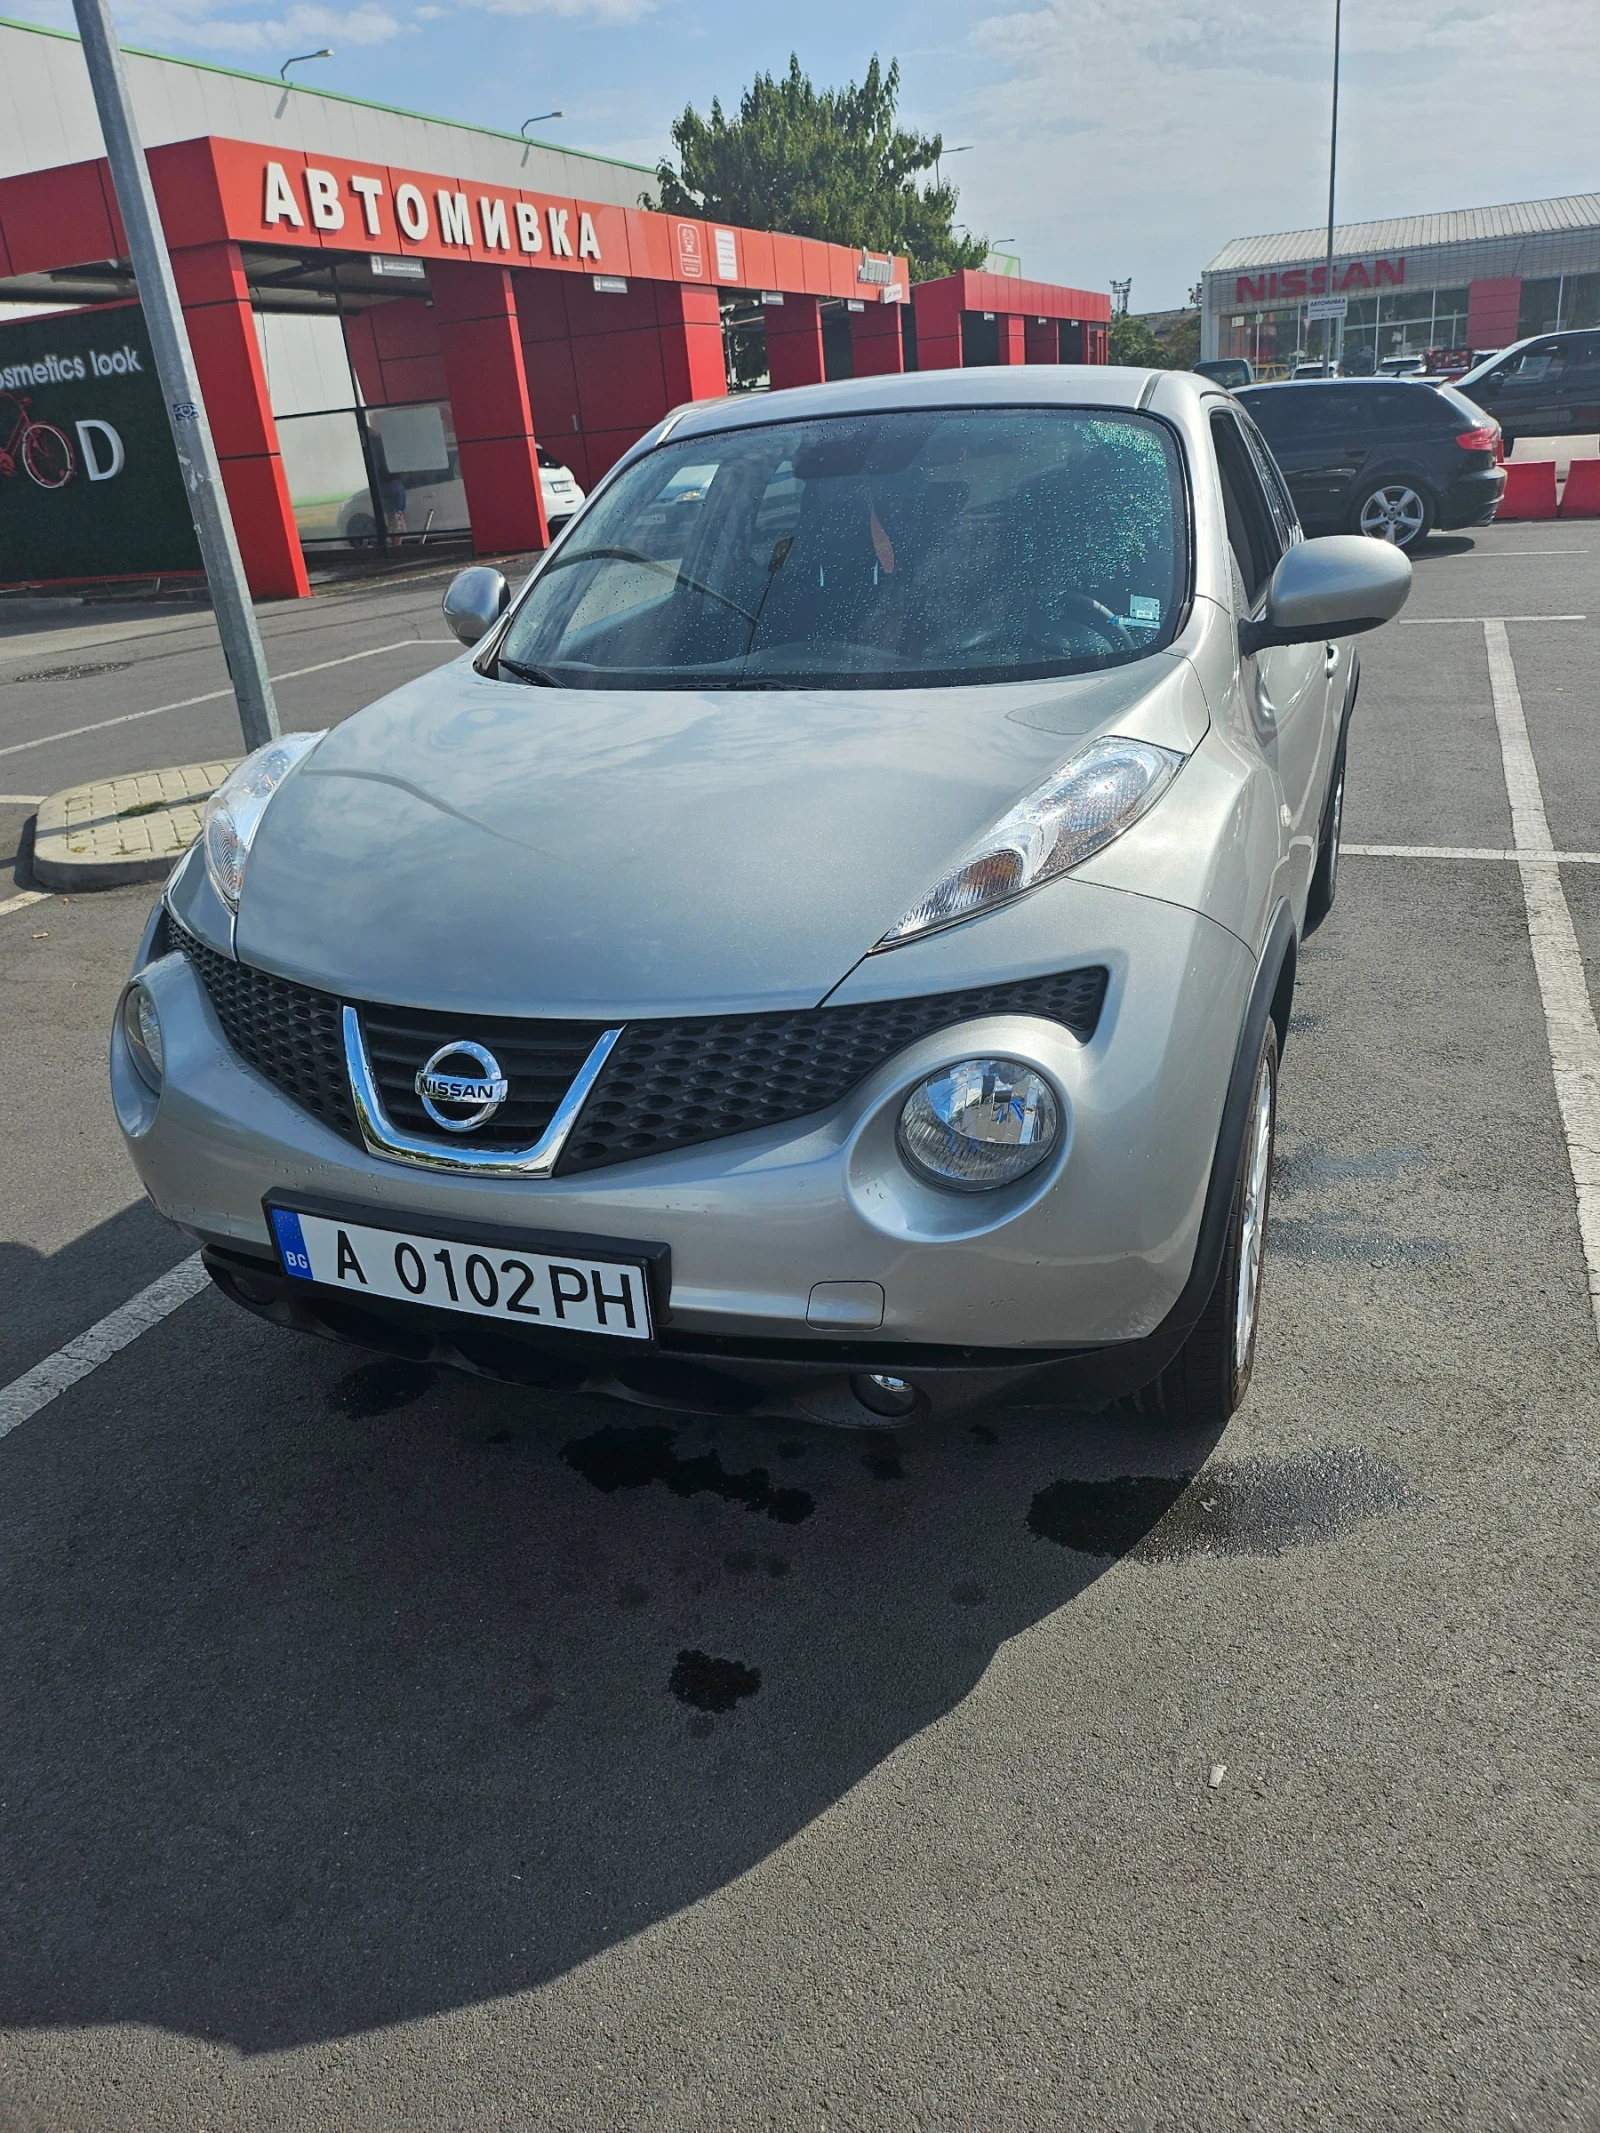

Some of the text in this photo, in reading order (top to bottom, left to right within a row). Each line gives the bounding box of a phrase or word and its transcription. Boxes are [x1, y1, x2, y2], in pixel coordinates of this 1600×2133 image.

[265, 161, 602, 260] АВТОМИВКА
[1236, 257, 1405, 303] NISSAN
[0, 345, 143, 391] smetics look
[419, 1077, 494, 1099] NISSAN
[285, 1251, 308, 1269] BG
[337, 1229, 368, 1285] A
